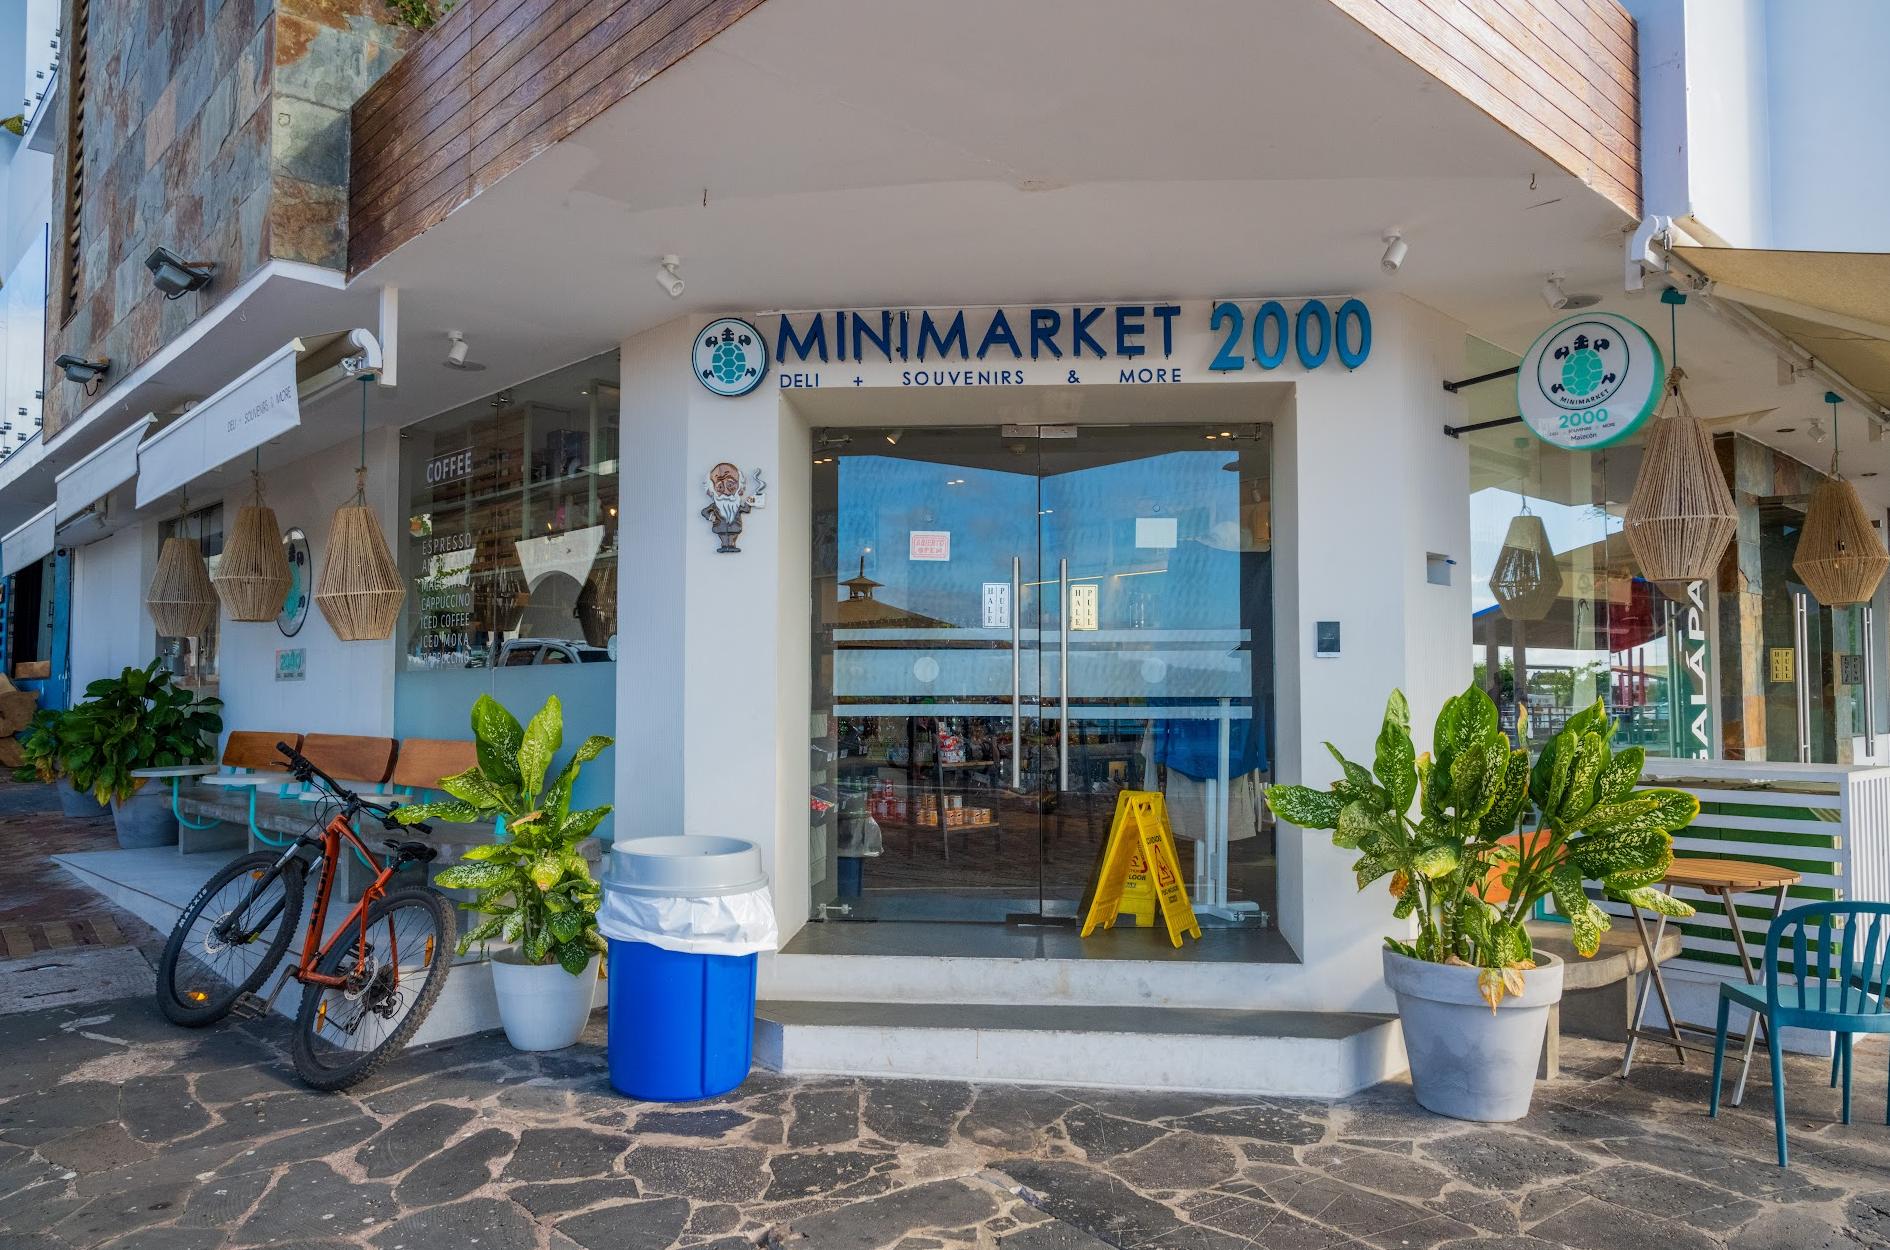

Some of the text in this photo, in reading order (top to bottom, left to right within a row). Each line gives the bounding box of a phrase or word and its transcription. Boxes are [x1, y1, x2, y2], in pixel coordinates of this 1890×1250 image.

[776, 299, 1372, 371] MINIMARKET 2000
[780, 368, 1182, 388] DELI + SOUVENIRS & MORE
[1560, 388, 1610, 405] MINIMARKET
[1559, 408, 1608, 429] 2000
[426, 452, 472, 483] COFFEE
[422, 532, 472, 555] ESPRESSO
[421, 592, 470, 611] CAPPUCCINO
[420, 612, 470, 630] ICED COFFEE
[420, 632, 469, 648] ICED MOKA
[1686, 580, 1709, 760] ALÁPA
[178, 888, 207, 928] MAXXIS
